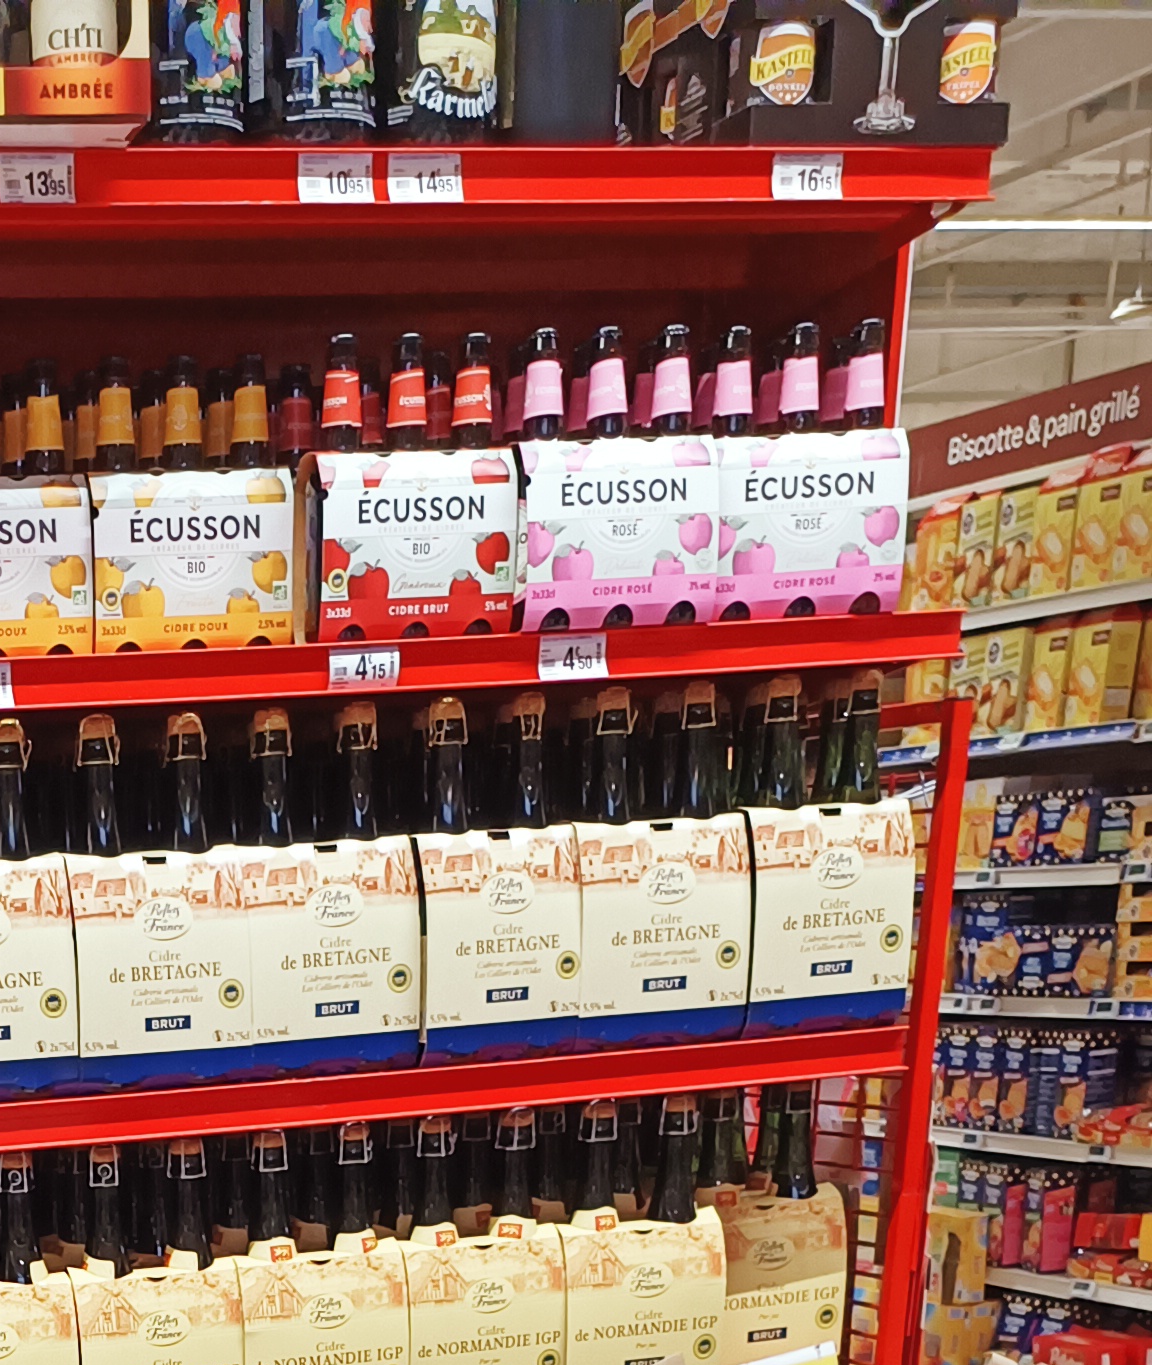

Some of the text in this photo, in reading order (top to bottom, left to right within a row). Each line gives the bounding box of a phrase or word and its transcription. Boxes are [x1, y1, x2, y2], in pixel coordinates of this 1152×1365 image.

[48, 26, 104, 51] CH'TI
[756, 49, 813, 80] KASTEEL
[39, 78, 113, 100] AMBRÉE
[948, 383, 1141, 466] Biscotte & pain grillé
[562, 474, 687, 508] ÉCUSSON
[745, 470, 876, 504] ÉCUSSON
[358, 491, 486, 524] ÉCUSSON
[130, 510, 261, 544] ÉCUSSON
[612, 519, 639, 536] ROSÉ
[795, 516, 822, 532] ROSÉ
[412, 542, 431, 556] BIO
[187, 560, 206, 575] BIO
[592, 582, 652, 595] CIDRE ROSÉ
[773, 575, 836, 590] CIDRE ROSÉ
[388, 602, 450, 614] CIDRE BRUT
[163, 622, 228, 633] CIDRE DOUX
[820, 898, 851, 910] Cidre
[651, 914, 683, 926] Cidre
[783, 908, 886, 932] de BRETAGNE
[493, 923, 523, 936] Cidre
[611, 924, 721, 947] de BRETAGNE
[320, 937, 352, 949] Cidre
[456, 934, 561, 957] de BRETAGNE
[149, 949, 182, 962] Cidre
[281, 948, 391, 970] de BRETAGNE
[109, 961, 222, 984] de BRETAGNE
[648, 977, 681, 990] BRUT
[491, 988, 524, 1001] BRUT
[321, 1002, 353, 1015] BRUT
[152, 1017, 185, 1030] BRUT
[814, 1285, 839, 1301] IGP
[594, 1314, 718, 1340] NORMANDIE IGP
[436, 1329, 561, 1356] NORMANDIE IGP
[377, 1346, 404, 1362] IGP
